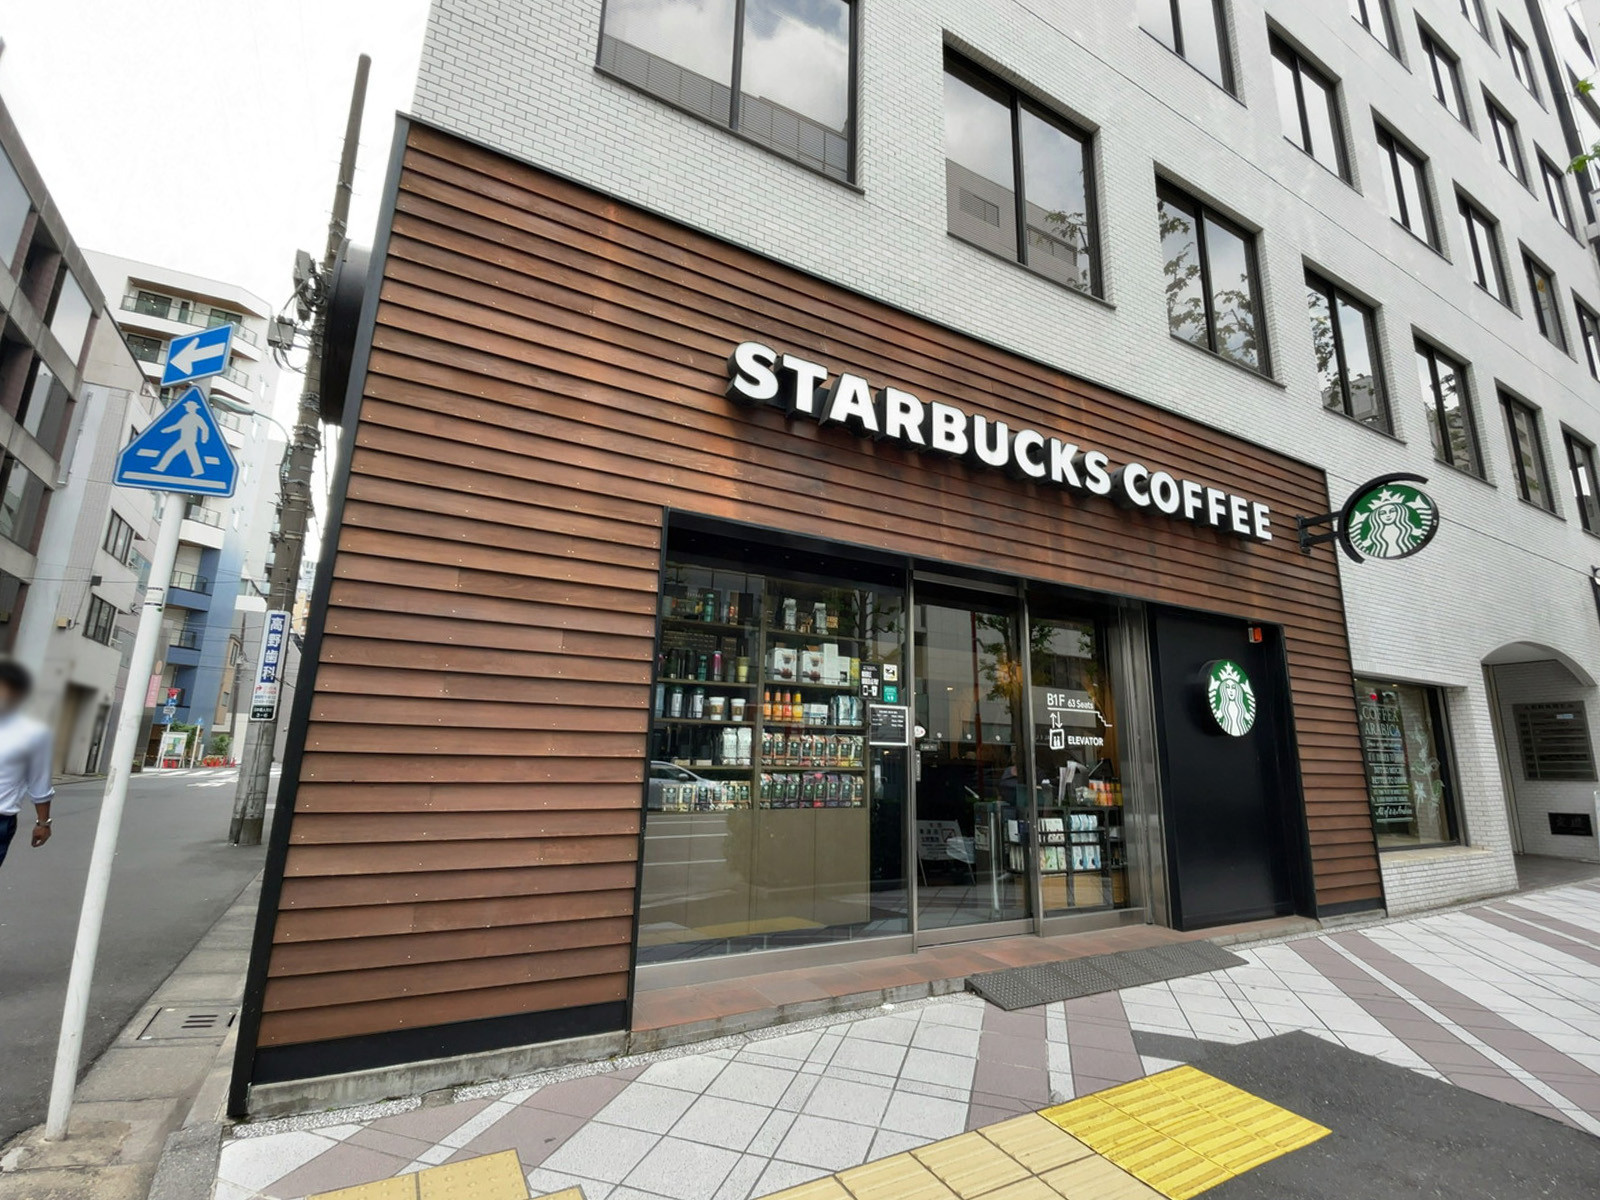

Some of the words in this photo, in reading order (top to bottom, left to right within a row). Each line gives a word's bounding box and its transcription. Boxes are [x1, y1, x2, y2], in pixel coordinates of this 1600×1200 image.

[733, 341, 1112, 496] STARBUCKS
[1122, 461, 1273, 542] COFFEE
[262, 617, 284, 680] 高野歯科
[1047, 693, 1065, 707] B1F
[1067, 698, 1076, 708] 63
[1076, 699, 1094, 710] Seats
[1365, 722, 1401, 738] ARABICA
[1067, 735, 1104, 746] ELEVATOR
